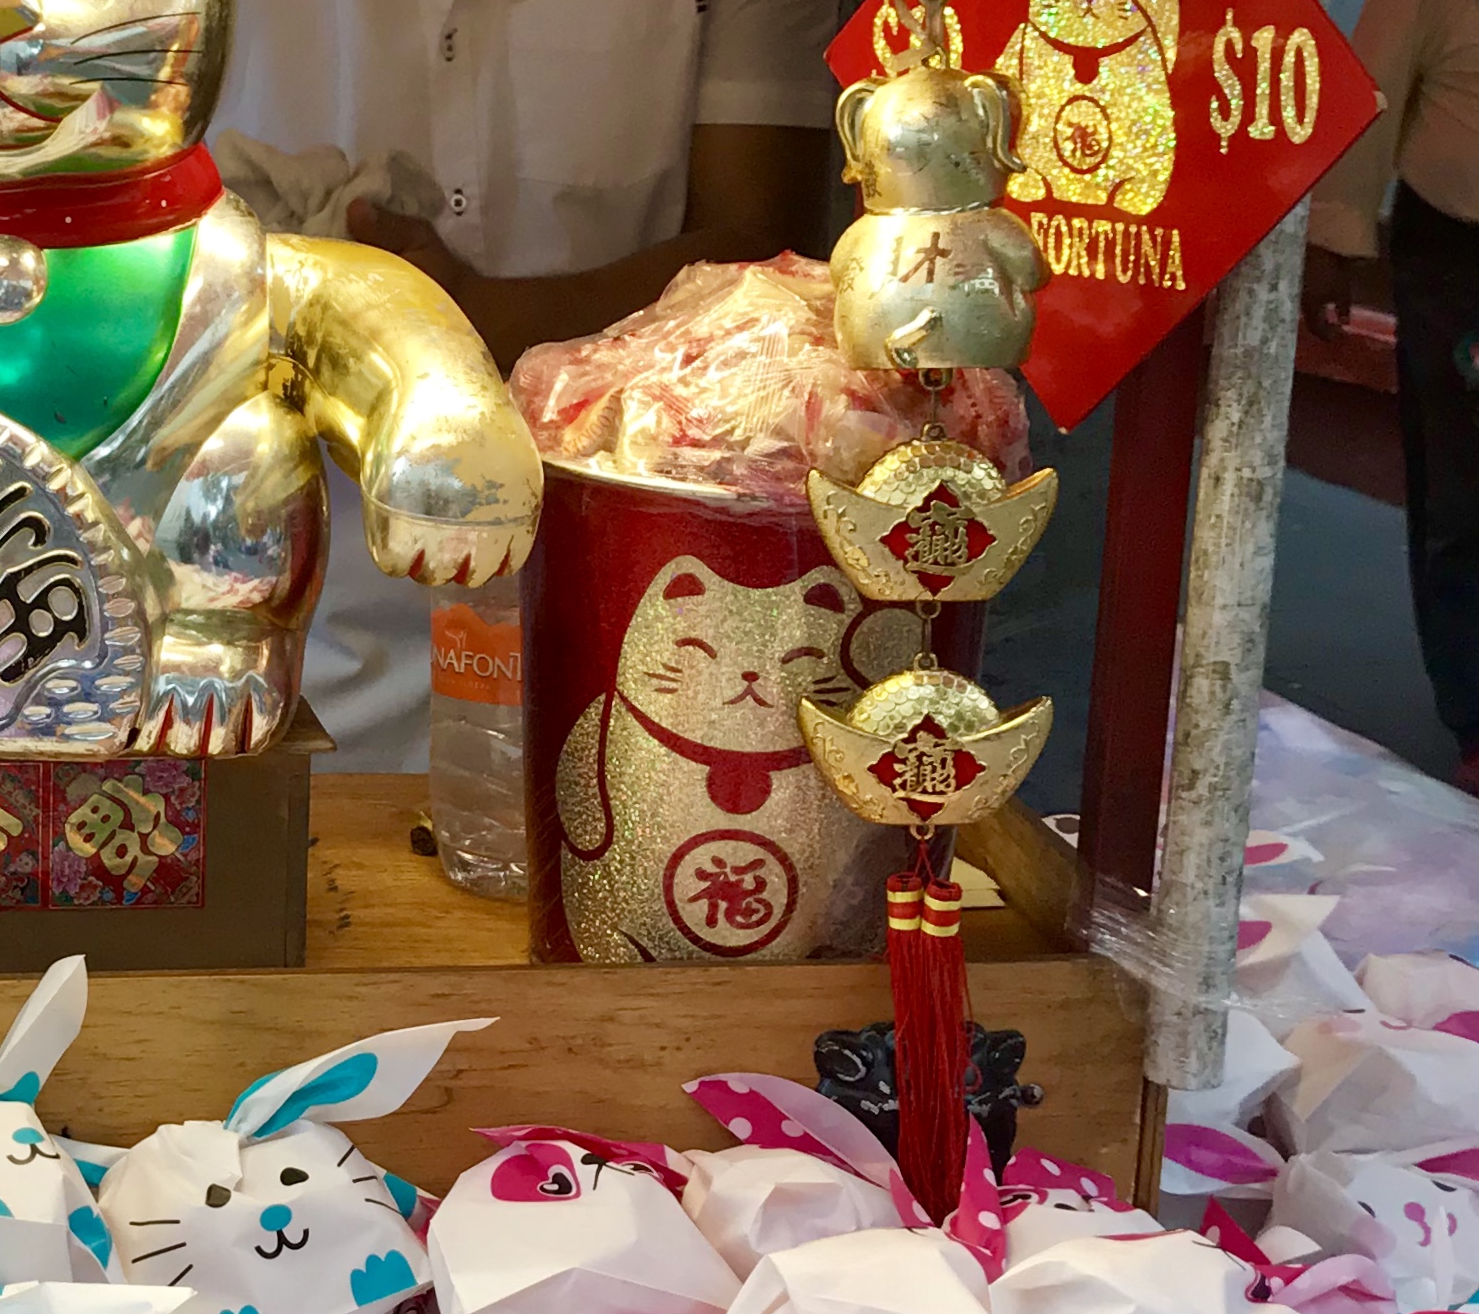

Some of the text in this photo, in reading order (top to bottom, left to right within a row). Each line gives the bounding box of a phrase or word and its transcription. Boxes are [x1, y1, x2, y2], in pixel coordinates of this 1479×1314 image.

[1209, 7, 1321, 155] $10
[1029, 211, 1187, 291] FORTUNA
[686, 854, 774, 931] 福
